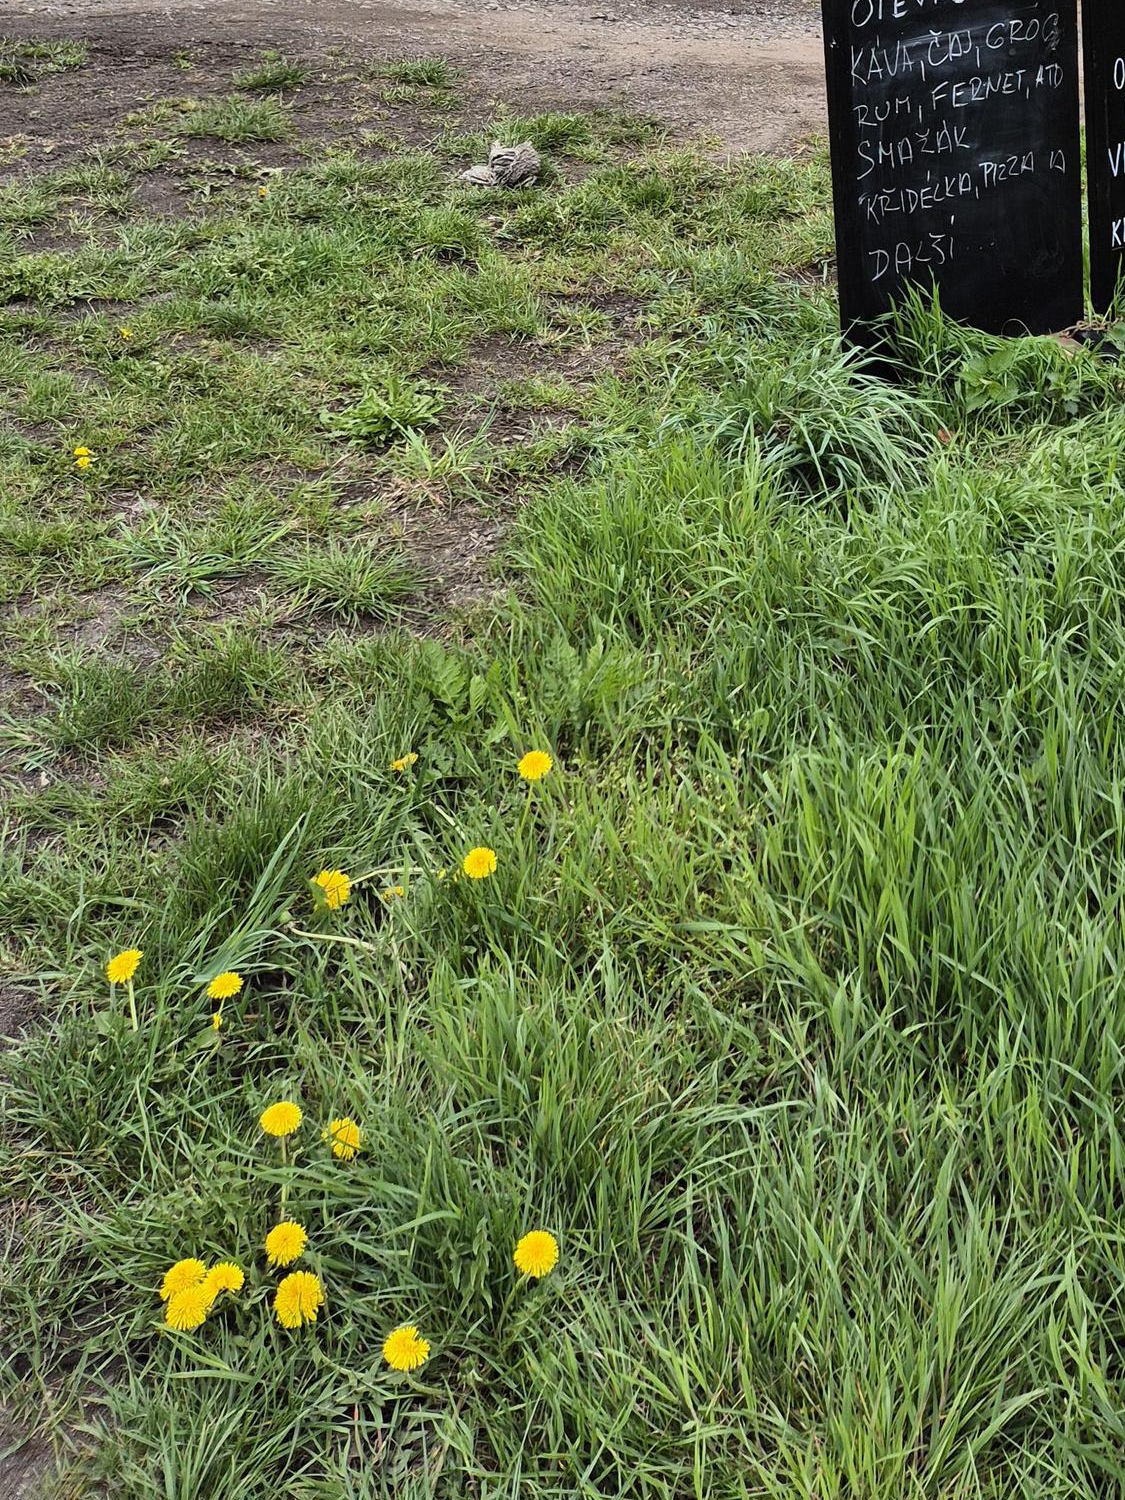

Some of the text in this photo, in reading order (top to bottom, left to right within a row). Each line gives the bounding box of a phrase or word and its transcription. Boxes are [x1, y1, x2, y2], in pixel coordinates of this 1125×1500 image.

[1035, 62, 1064, 89] ATD
[857, 119, 971, 181] SMAŽÁK
[978, 151, 1034, 188] PIZZA
[1049, 150, 1066, 174] A
